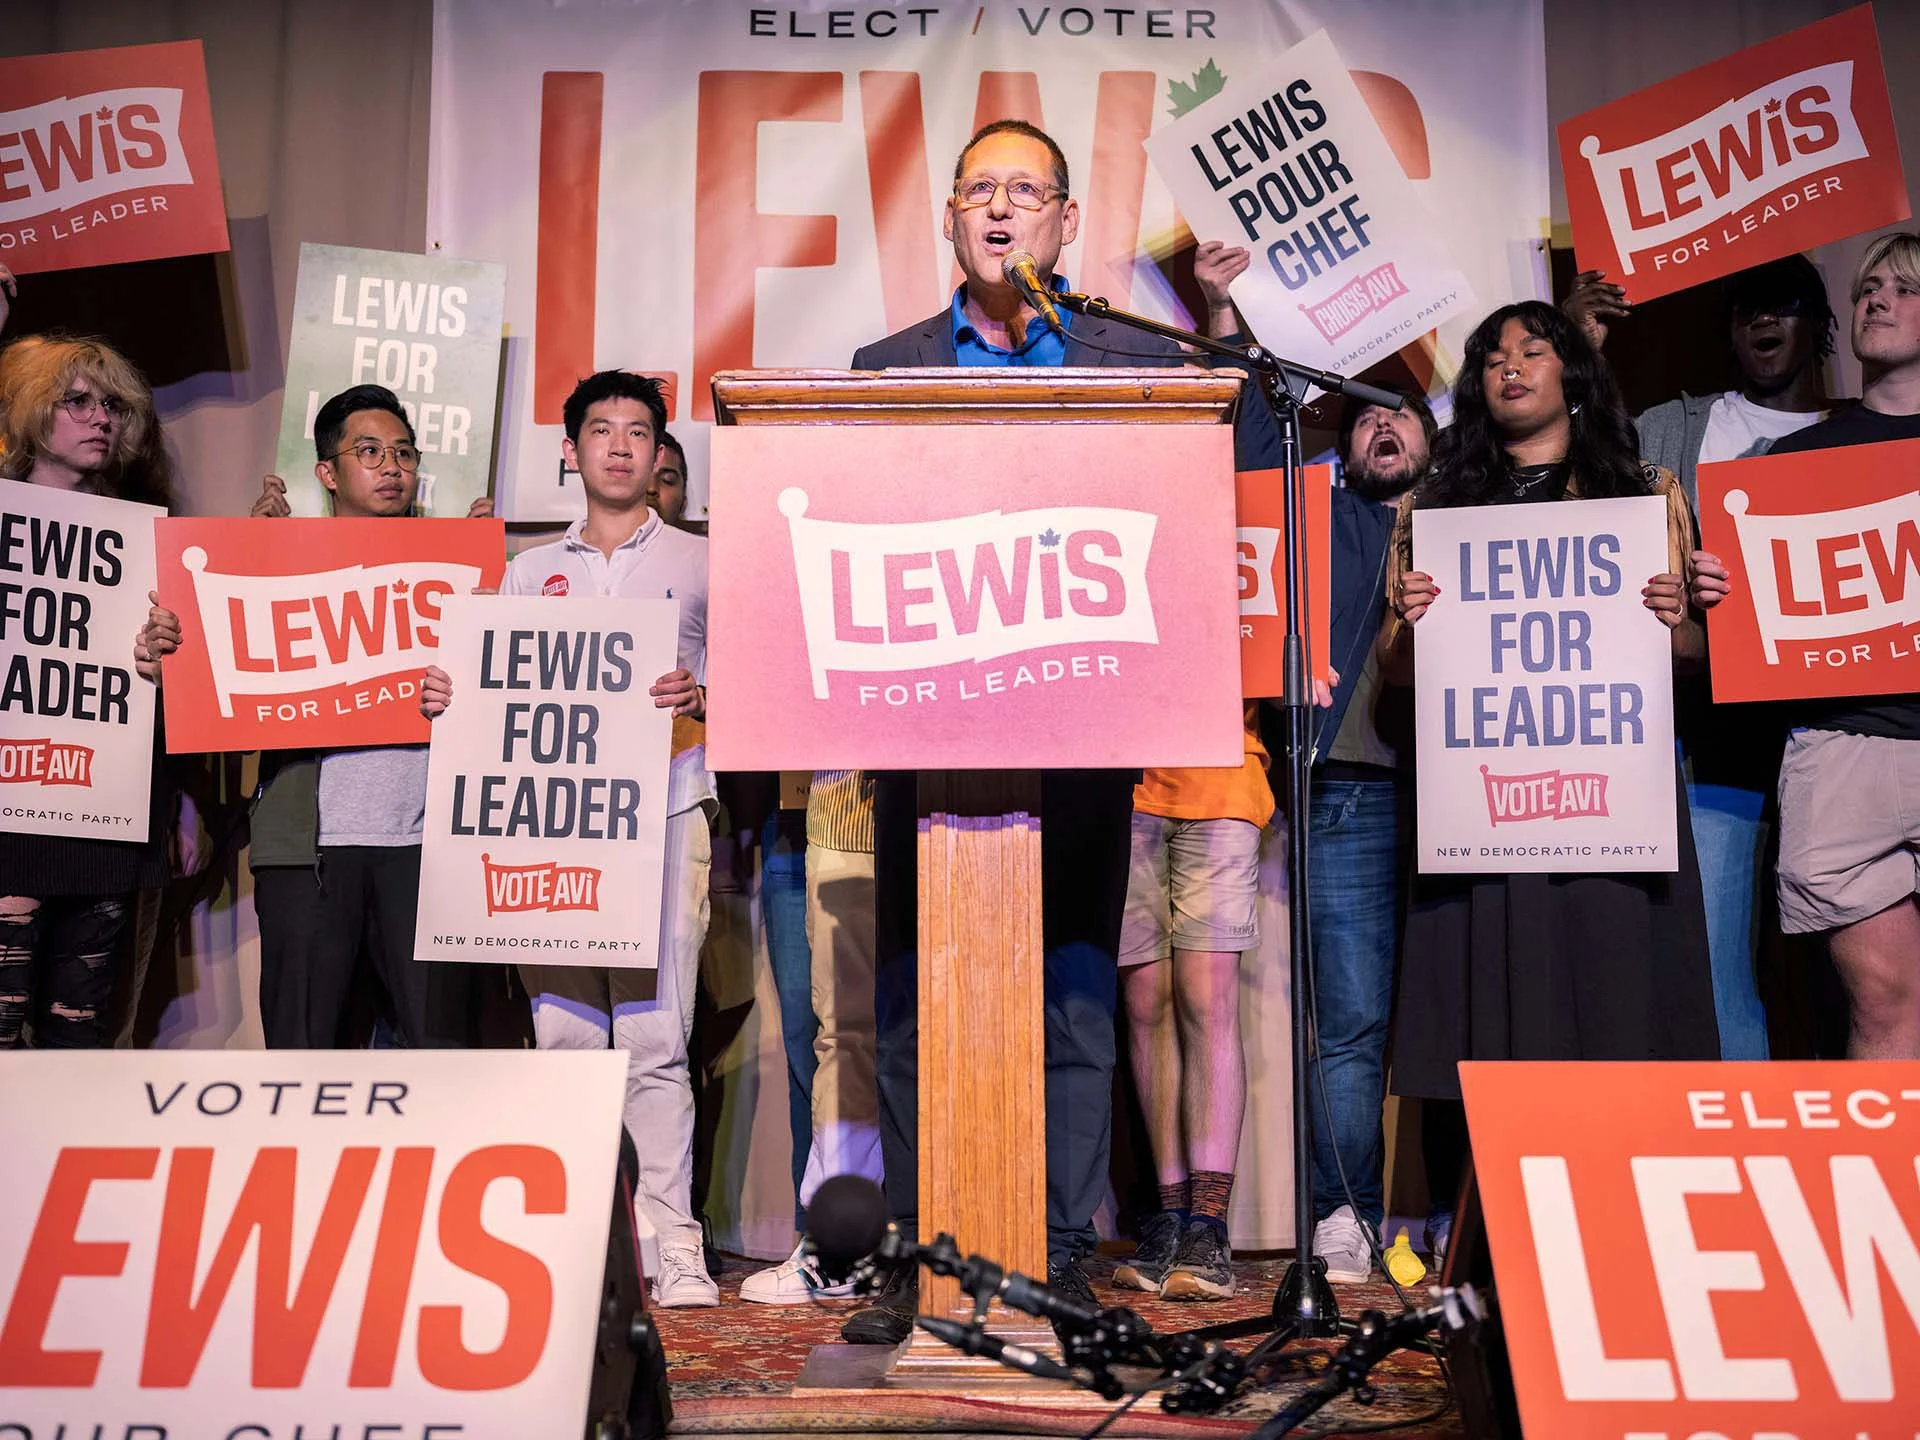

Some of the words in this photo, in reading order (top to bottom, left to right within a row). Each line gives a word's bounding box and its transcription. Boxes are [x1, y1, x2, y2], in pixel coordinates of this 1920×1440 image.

[748, 8, 940, 38] ELECT
[1017, 7, 1217, 38] VOTER
[1190, 78, 1327, 192] LEWIS
[1228, 139, 1353, 242] POUR
[0, 228, 38, 249] OR
[51, 196, 169, 240] LEADER
[534, 70, 1432, 425] LEW
[1267, 194, 1371, 291] CHEF
[1653, 237, 1710, 271] FOR
[1723, 176, 1843, 244] LEADER
[332, 274, 468, 338] LEWIS
[1315, 281, 1370, 337] CHOISIS
[1332, 319, 1413, 371] DEMOCRATIC
[1417, 291, 1458, 320] PARTY
[351, 336, 438, 394] FOR
[0, 512, 124, 587] EWIS
[1460, 534, 1622, 601] LEWIS
[1771, 519, 1920, 616] LEW
[0, 581, 91, 651] FOR
[1491, 610, 1592, 673] FOR
[480, 630, 634, 692] LEWIS
[859, 681, 937, 706] FOR
[959, 655, 1121, 700] LEADER
[1804, 643, 1872, 669] FOR
[0, 654, 131, 724] ADER
[256, 701, 319, 722] FOR
[335, 678, 425, 715] LEAD
[1444, 683, 1644, 748] LEADER
[0, 744, 45, 778] OTE
[502, 703, 600, 764] FOR
[2, 807, 73, 822] OCRATIC
[82, 814, 133, 826] PARTY
[451, 775, 641, 840] LEADER
[1491, 777, 1556, 817] VOTE
[1437, 848, 1472, 857] NEW
[1480, 846, 1592, 857] DEMOCRATIC
[1601, 845, 1659, 856] PARTY
[491, 868, 551, 907] VOTE
[433, 935, 466, 945] NEW
[474, 936, 580, 949] DEMOCRATIC
[587, 940, 641, 951] PARTY
[143, 1082, 410, 1116] VOTER
[1687, 1089, 1920, 1129] ELEC
[0, 1144, 567, 1391] EWIS
[1519, 1155, 1920, 1402] LEW
